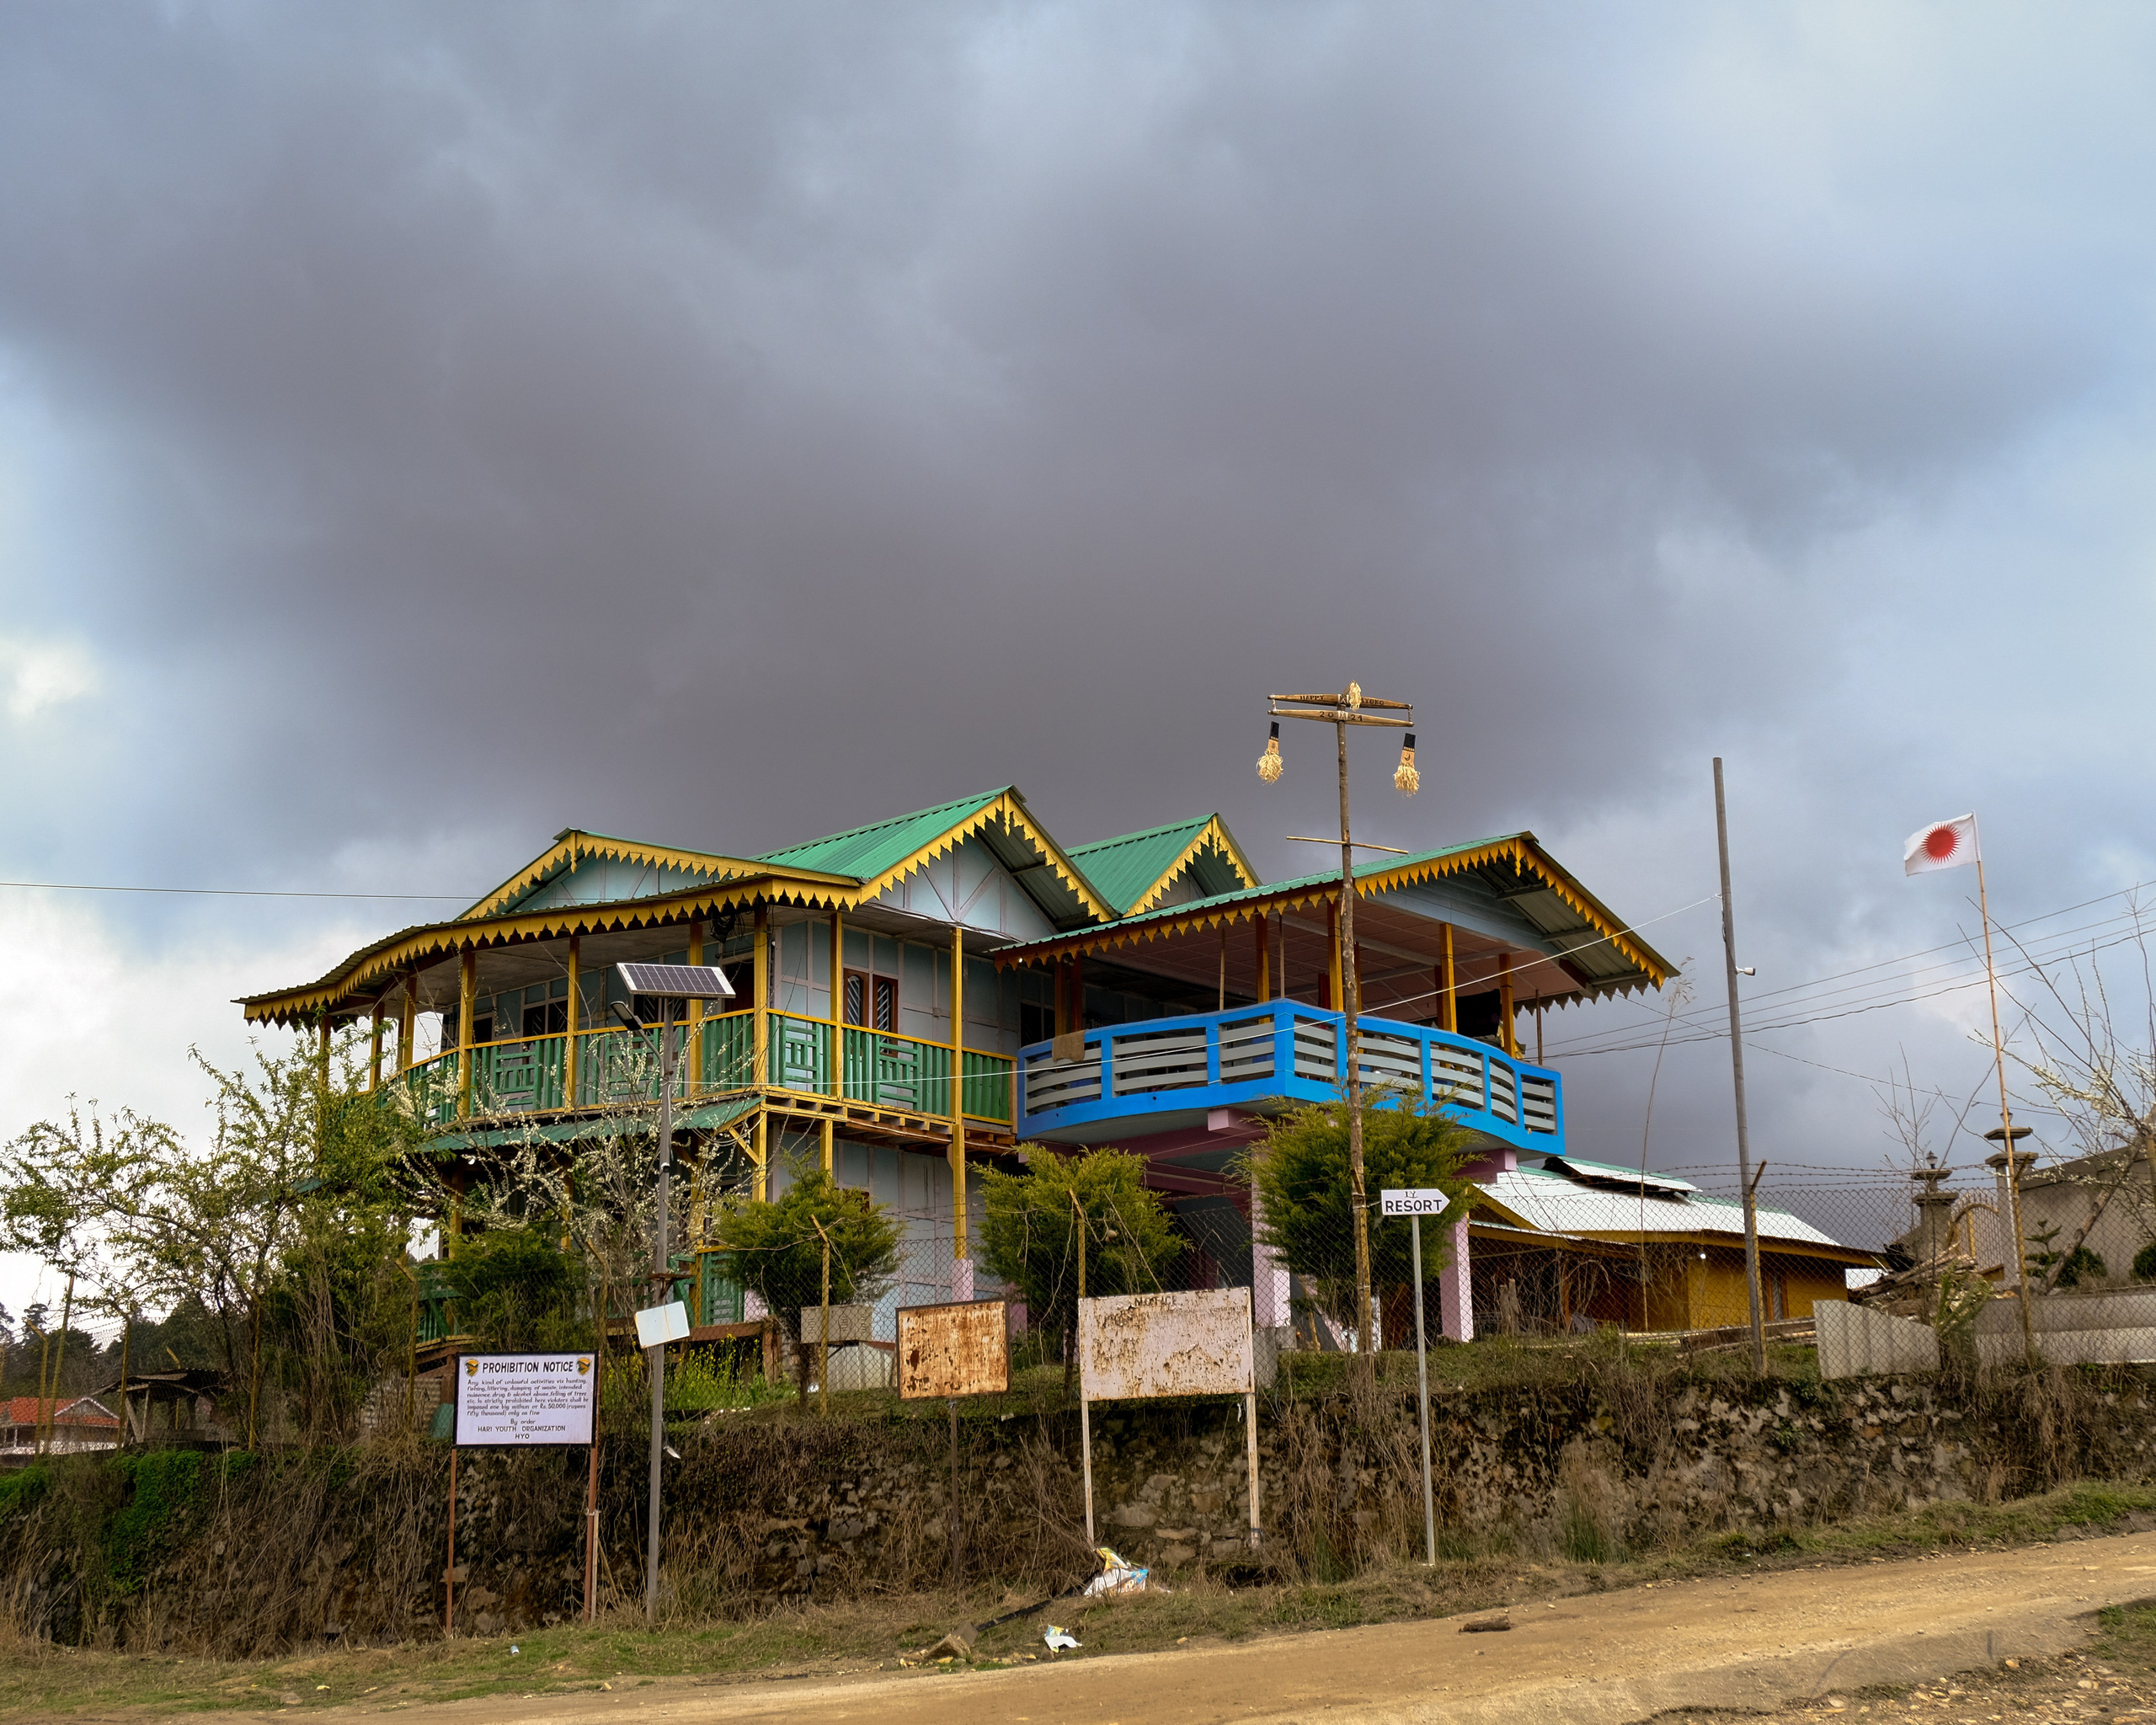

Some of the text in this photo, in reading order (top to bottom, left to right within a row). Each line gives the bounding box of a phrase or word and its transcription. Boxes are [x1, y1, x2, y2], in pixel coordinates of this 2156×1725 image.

[1385, 1200, 1442, 1212] RESORT
[1135, 1295, 1177, 1306] NOTICE
[483, 1362, 573, 1373] PROHIBITION NOTICE
